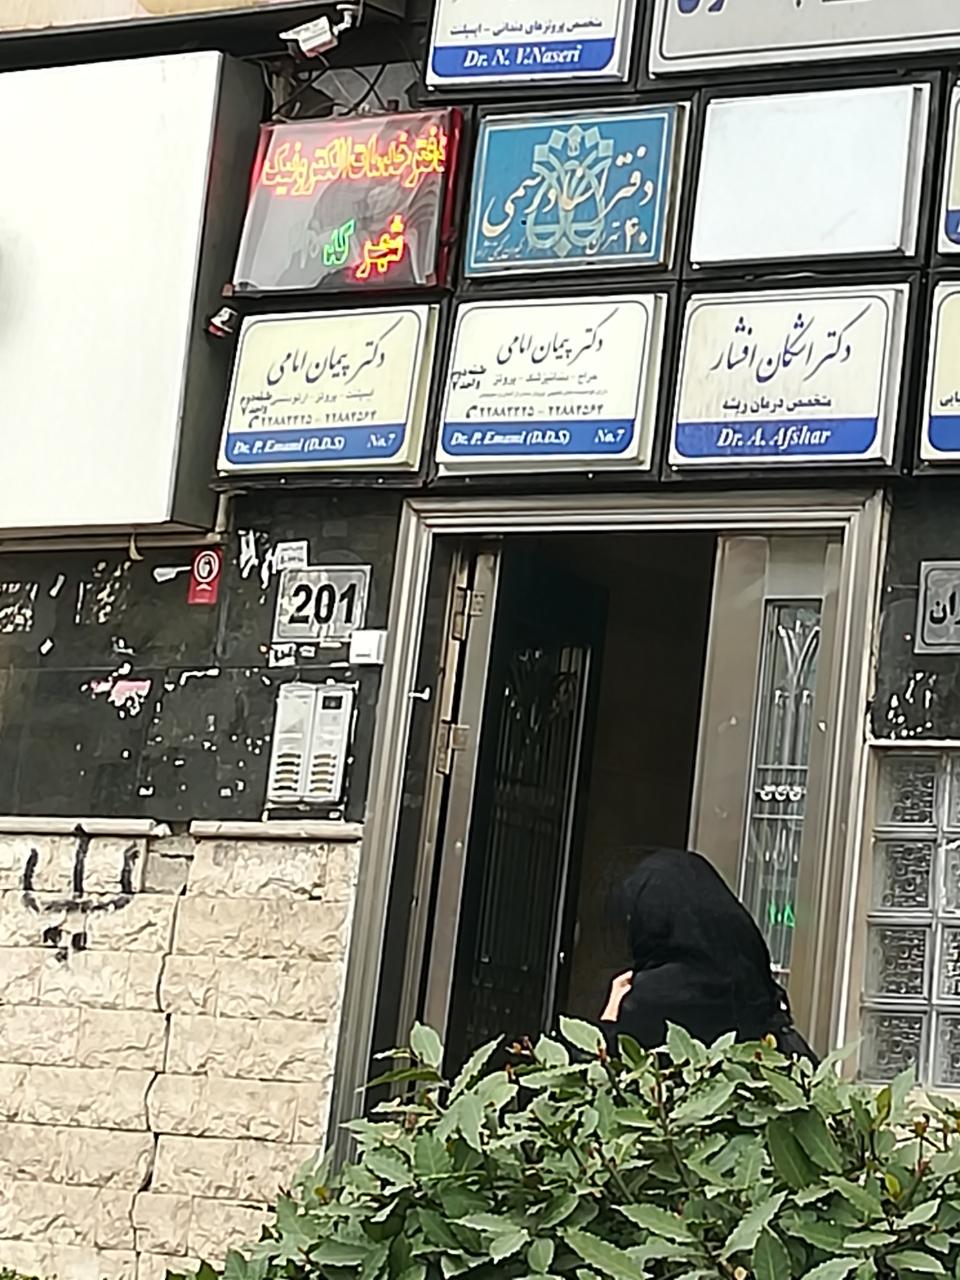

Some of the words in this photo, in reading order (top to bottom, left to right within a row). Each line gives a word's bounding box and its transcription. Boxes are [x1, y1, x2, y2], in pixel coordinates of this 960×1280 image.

[463, 49, 489, 68] Dr.
[600, 146, 655, 216] دفتر
[345, 316, 404, 385] دکتر
[567, 307, 620, 366] دکتر
[755, 312, 815, 384] اشکان
[803, 302, 872, 381] دکتر
[750, 395, 784, 414] درمان
[786, 394, 832, 412] متخصص
[716, 428, 743, 447] Dr.
[746, 427, 766, 446] A.
[768, 425, 831, 450] Afshar
[287, 582, 358, 625] 201
